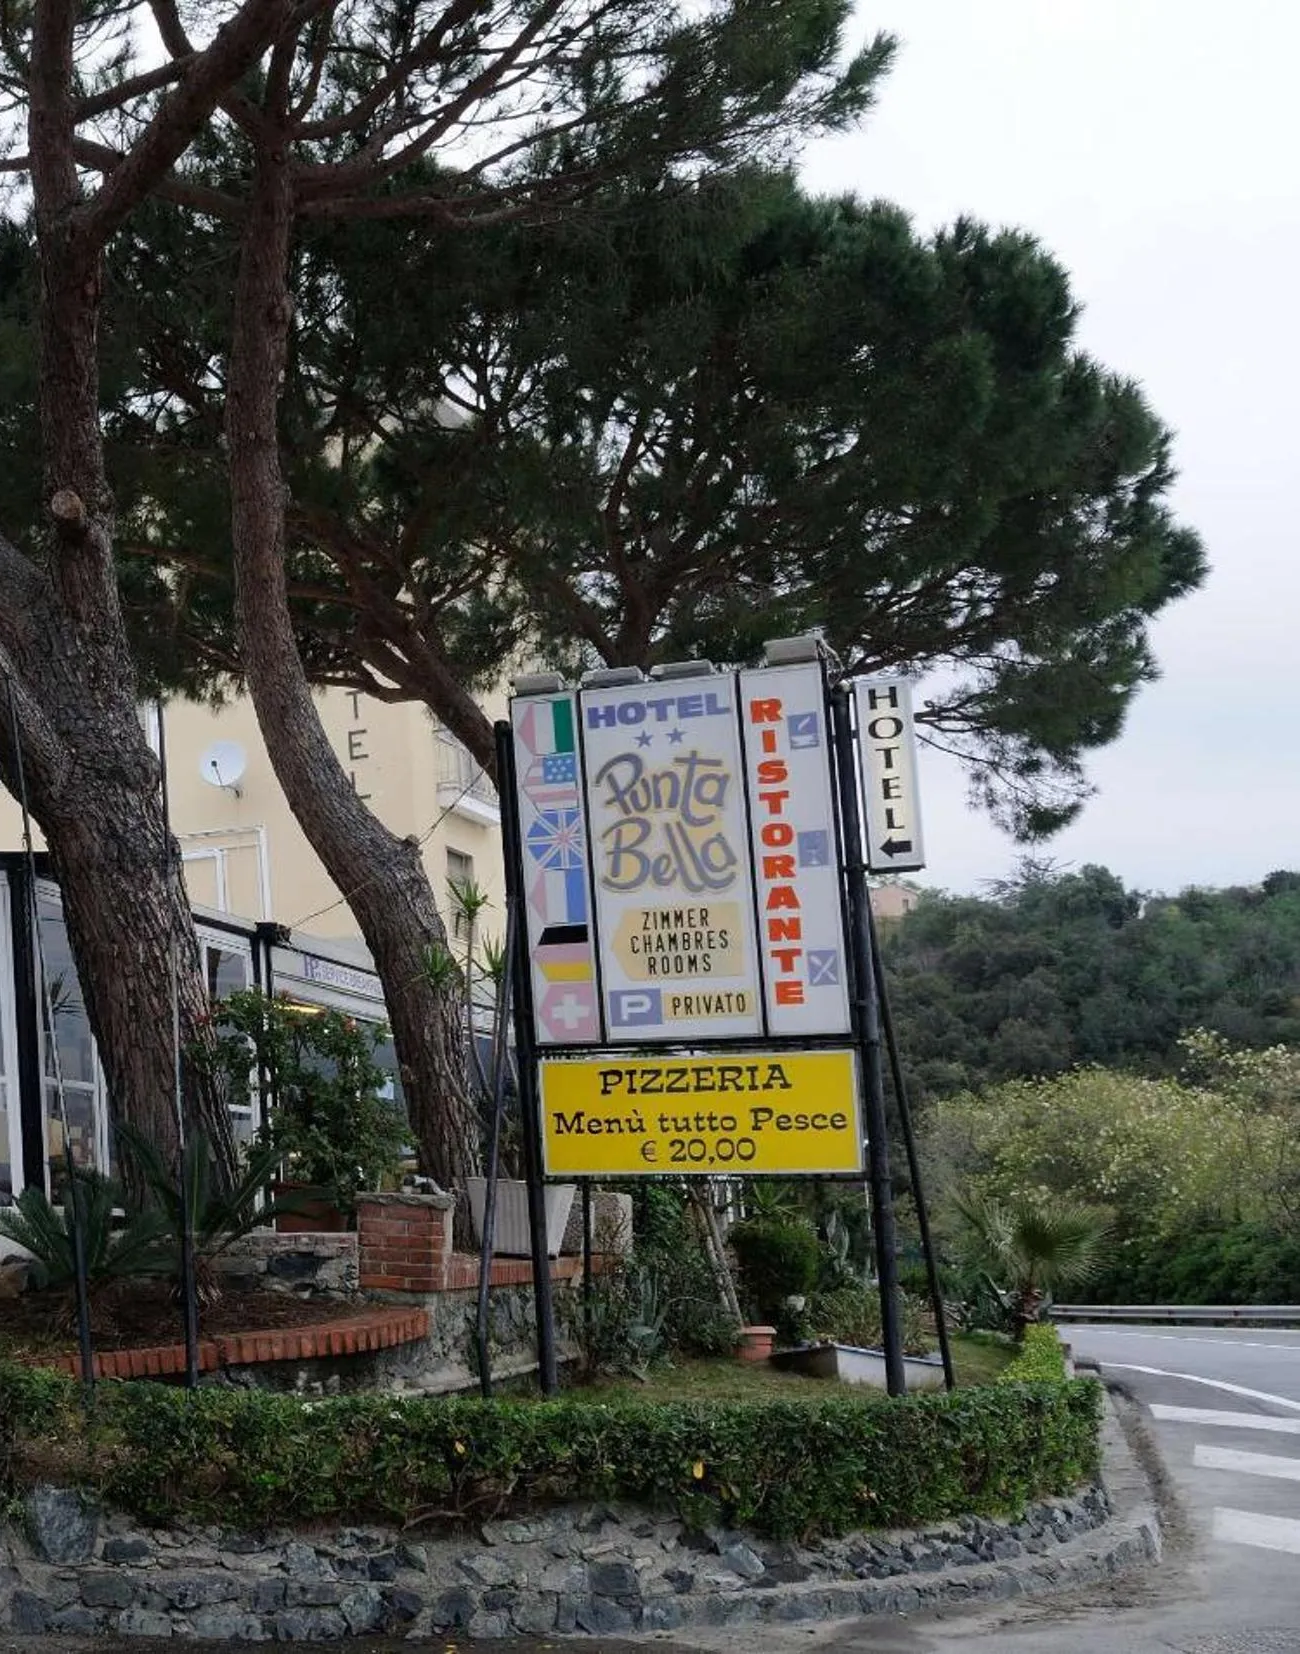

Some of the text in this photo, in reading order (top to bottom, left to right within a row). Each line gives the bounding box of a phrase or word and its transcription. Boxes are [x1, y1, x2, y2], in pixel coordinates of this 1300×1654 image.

[587, 693, 731, 728] HOTEL
[868, 686, 904, 830] HOTEL
[595, 750, 730, 827] Punta
[601, 816, 737, 893] Bella
[750, 698, 805, 1005] RISTORANTE
[641, 907, 710, 931] ZIMMER
[630, 929, 729, 954] CHAMBRES
[647, 953, 712, 975] ROOMS
[671, 993, 747, 1016] PRIVATO
[599, 1064, 792, 1096] PIZZERIA
[553, 1107, 848, 1135] Menù tutto Pesce
[640, 1138, 756, 1165] € 20,00
